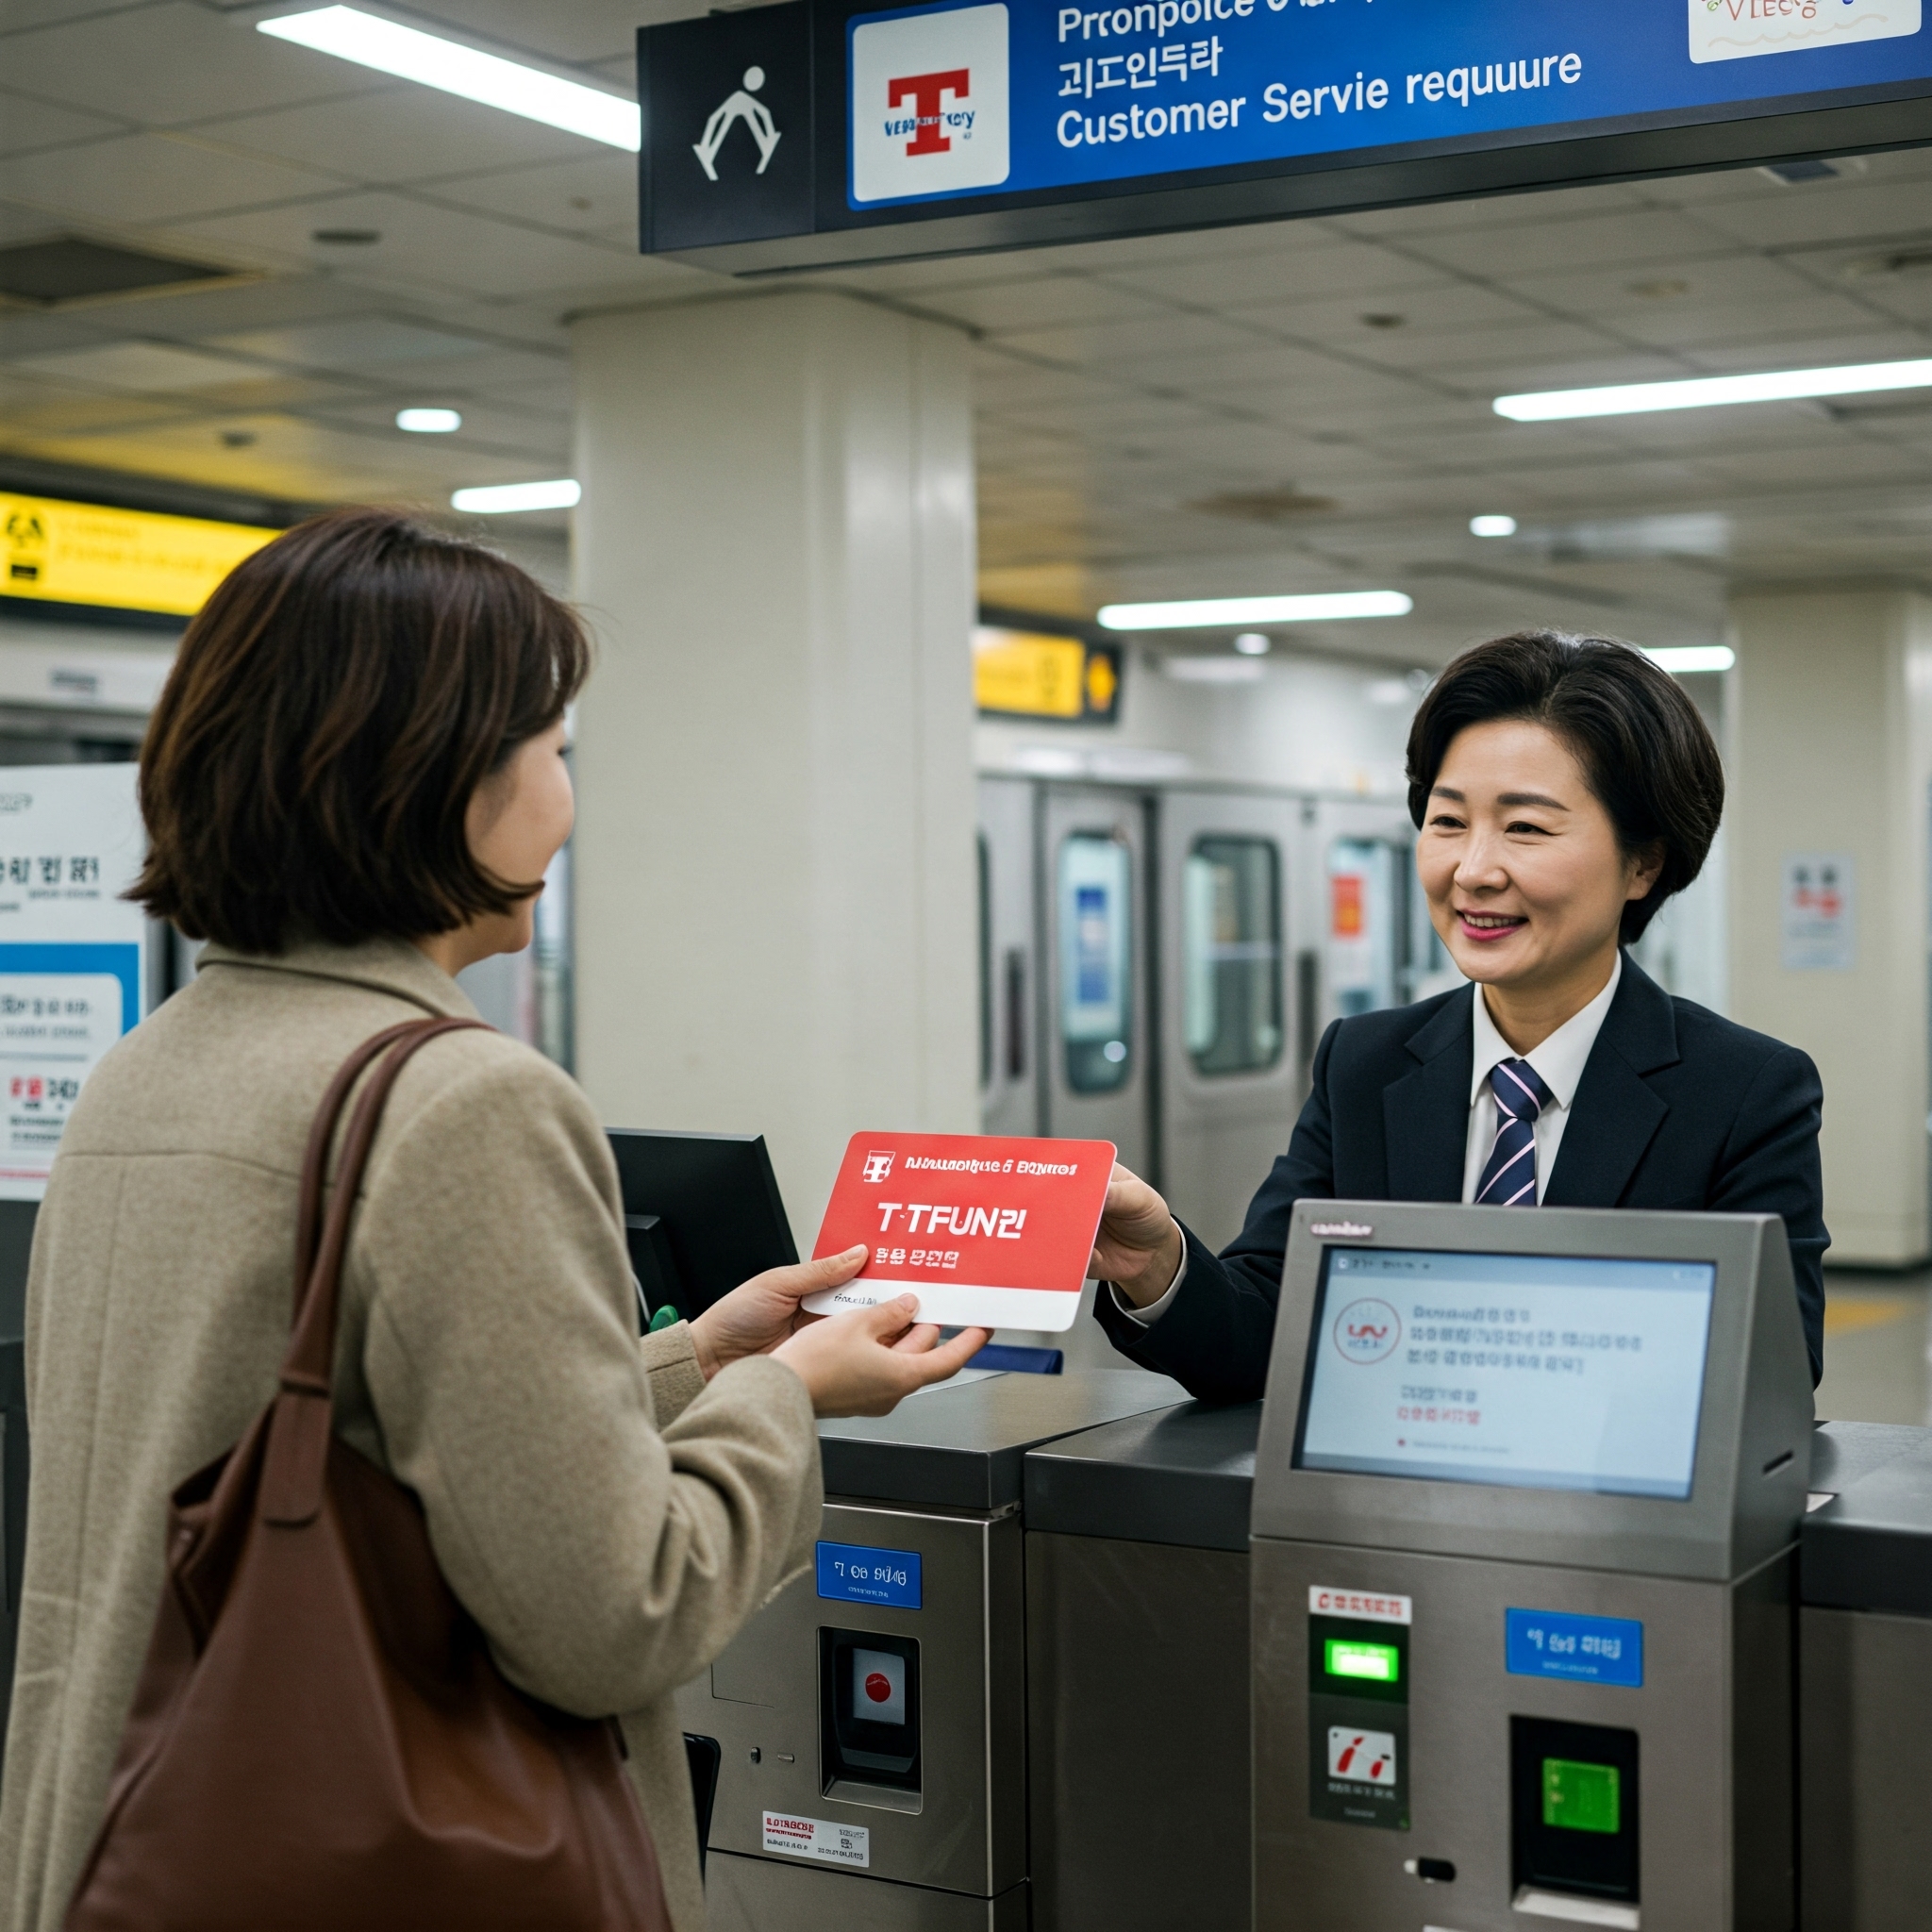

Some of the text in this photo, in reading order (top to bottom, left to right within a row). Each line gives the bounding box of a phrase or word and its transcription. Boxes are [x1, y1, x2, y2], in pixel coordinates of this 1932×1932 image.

[1057, 52, 1582, 148] Customer Servie requuure
